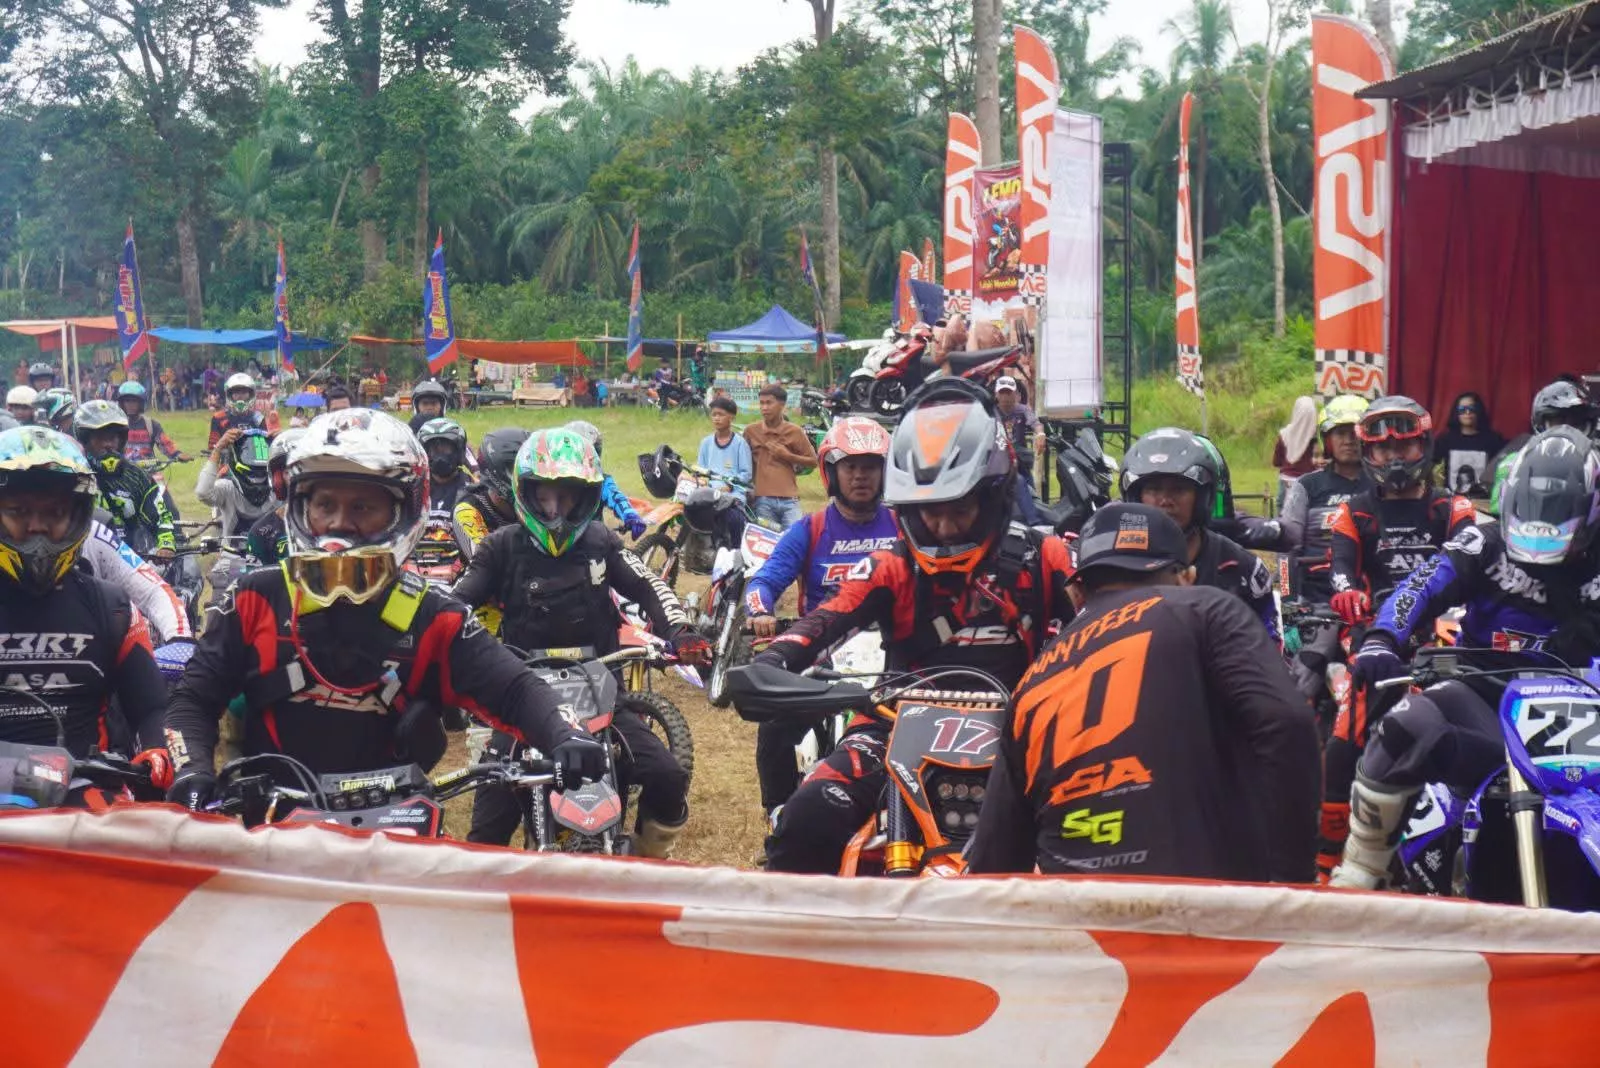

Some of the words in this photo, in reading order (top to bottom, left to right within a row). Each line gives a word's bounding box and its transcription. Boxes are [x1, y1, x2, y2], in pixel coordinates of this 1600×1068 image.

[1076, 595, 1165, 651] DEEP
[929, 716, 1002, 755] 17
[1061, 808, 1125, 846] SG
